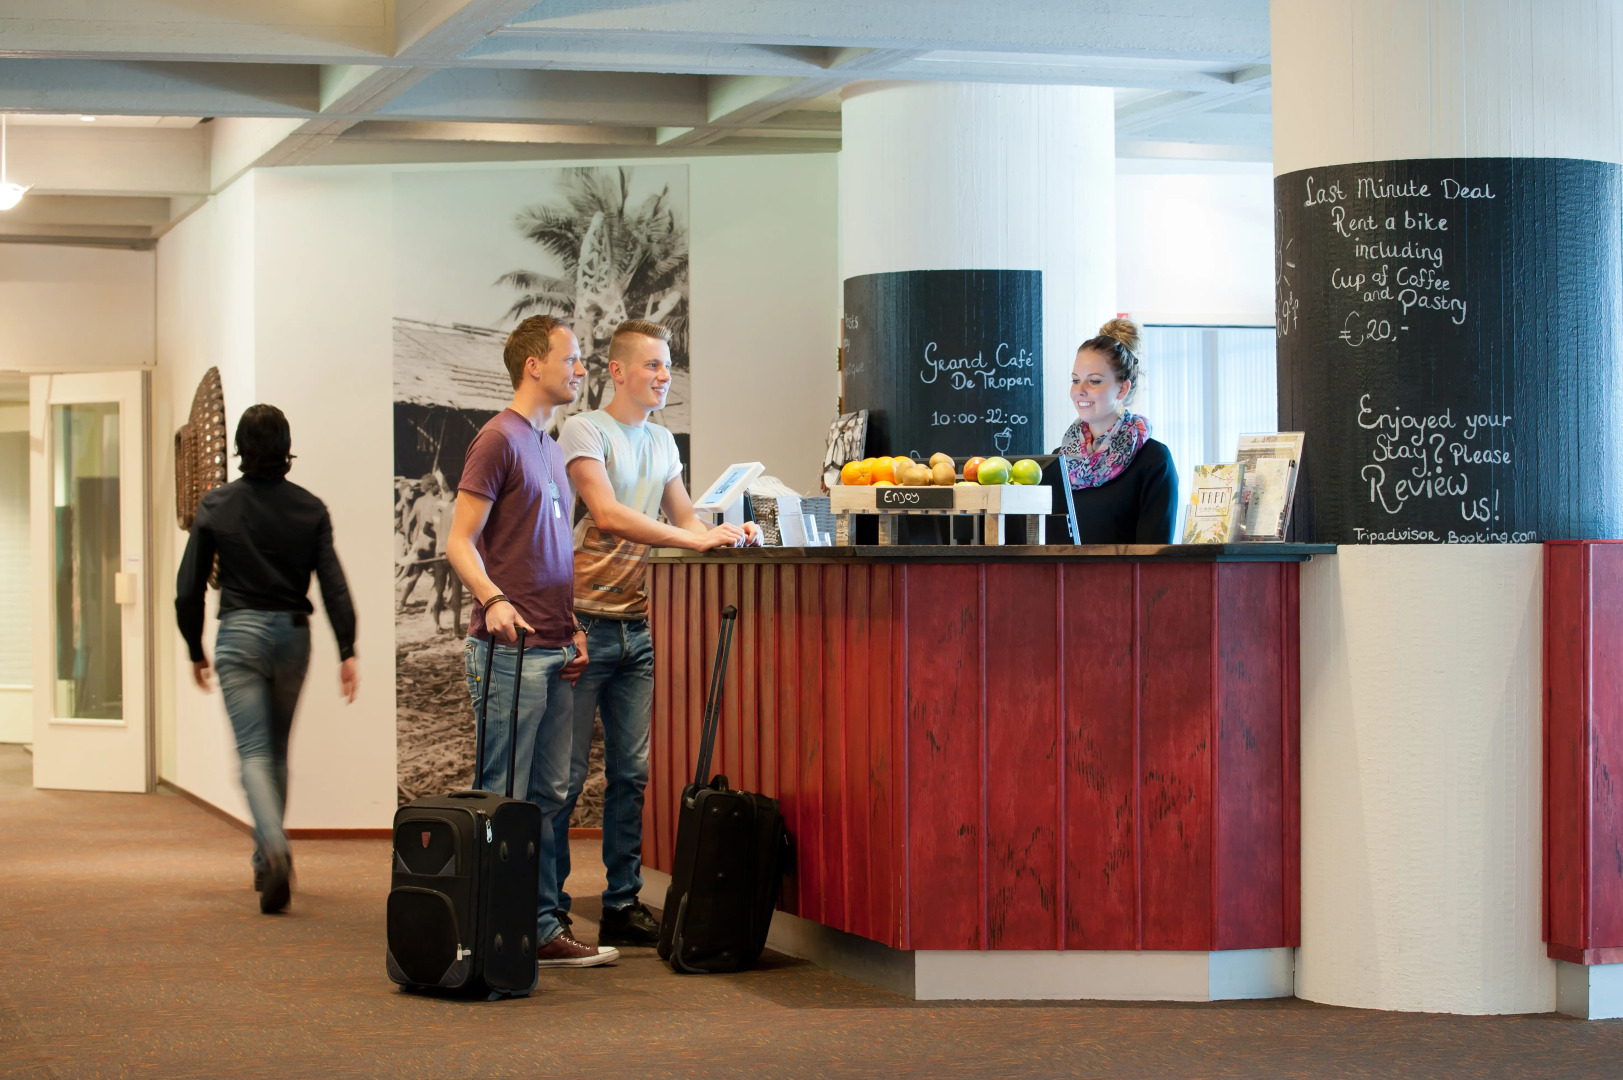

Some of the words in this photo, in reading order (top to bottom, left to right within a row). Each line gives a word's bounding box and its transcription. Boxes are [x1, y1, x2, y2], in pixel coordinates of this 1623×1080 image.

[1304, 176, 1347, 206] Last
[1357, 177, 1431, 200] Minute
[1441, 178, 1496, 200] Deal
[1332, 206, 1378, 237] Rent
[1385, 216, 1396, 230] a
[1404, 210, 1448, 231] bike
[1355, 237, 1443, 268] including
[1332, 268, 1365, 291] Cup
[1372, 264, 1388, 287] of
[1397, 266, 1450, 291] Coffee
[1363, 286, 1394, 302] and
[1398, 288, 1467, 325] Pastry
[995, 342, 1034, 369] Café
[951, 371, 976, 390] De
[1357, 393, 1457, 446] Enjoyed
[1463, 414, 1512, 440] your
[1373, 433, 1446, 478] Stay?
[1449, 442, 1512, 466] Please
[1361, 464, 1468, 515] Review
[1461, 489, 1500, 522] us!
[1447, 527, 1537, 545] Booking.com
